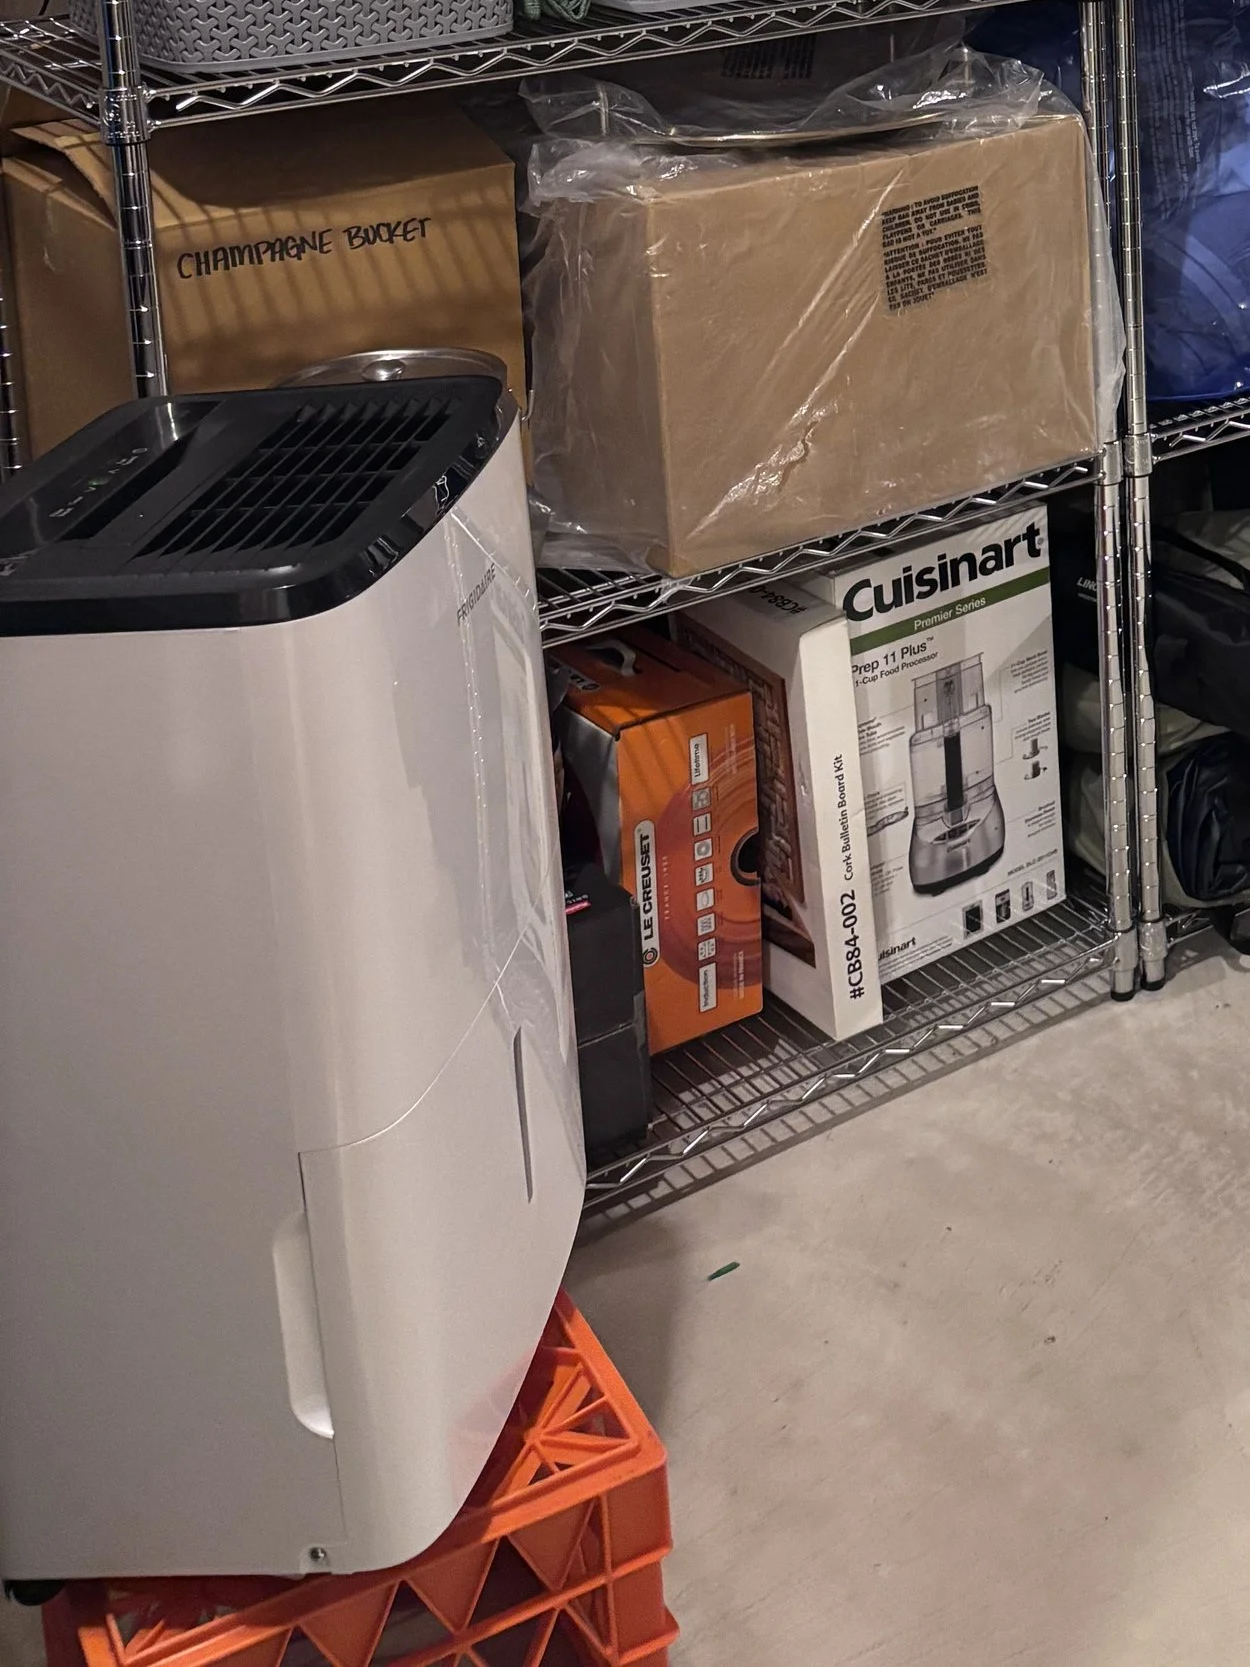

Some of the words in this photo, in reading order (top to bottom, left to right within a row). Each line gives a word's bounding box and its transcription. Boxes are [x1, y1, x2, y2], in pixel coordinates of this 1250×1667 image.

[911, 208, 927, 216] AWAY
[177, 228, 334, 279] CHAMPAGNE
[343, 217, 432, 250] BUCKET
[842, 521, 1042, 622] Cuisinart
[456, 562, 496, 627] FRIGIDAIRE
[913, 609, 953, 631] Premier
[955, 595, 987, 616] Series
[880, 665, 900, 679] Food
[901, 651, 939, 669] Processor
[883, 650, 896, 666] 11
[833, 754, 844, 772] Kit
[837, 774, 848, 808] Board
[839, 809, 853, 855] Bulletin
[639, 834, 653, 915] CREUSET
[844, 854, 854, 881] Cork
[643, 916, 654, 941] LE
[840, 889, 865, 1000] #CB84-002
[701, 969, 709, 1008] Induction
